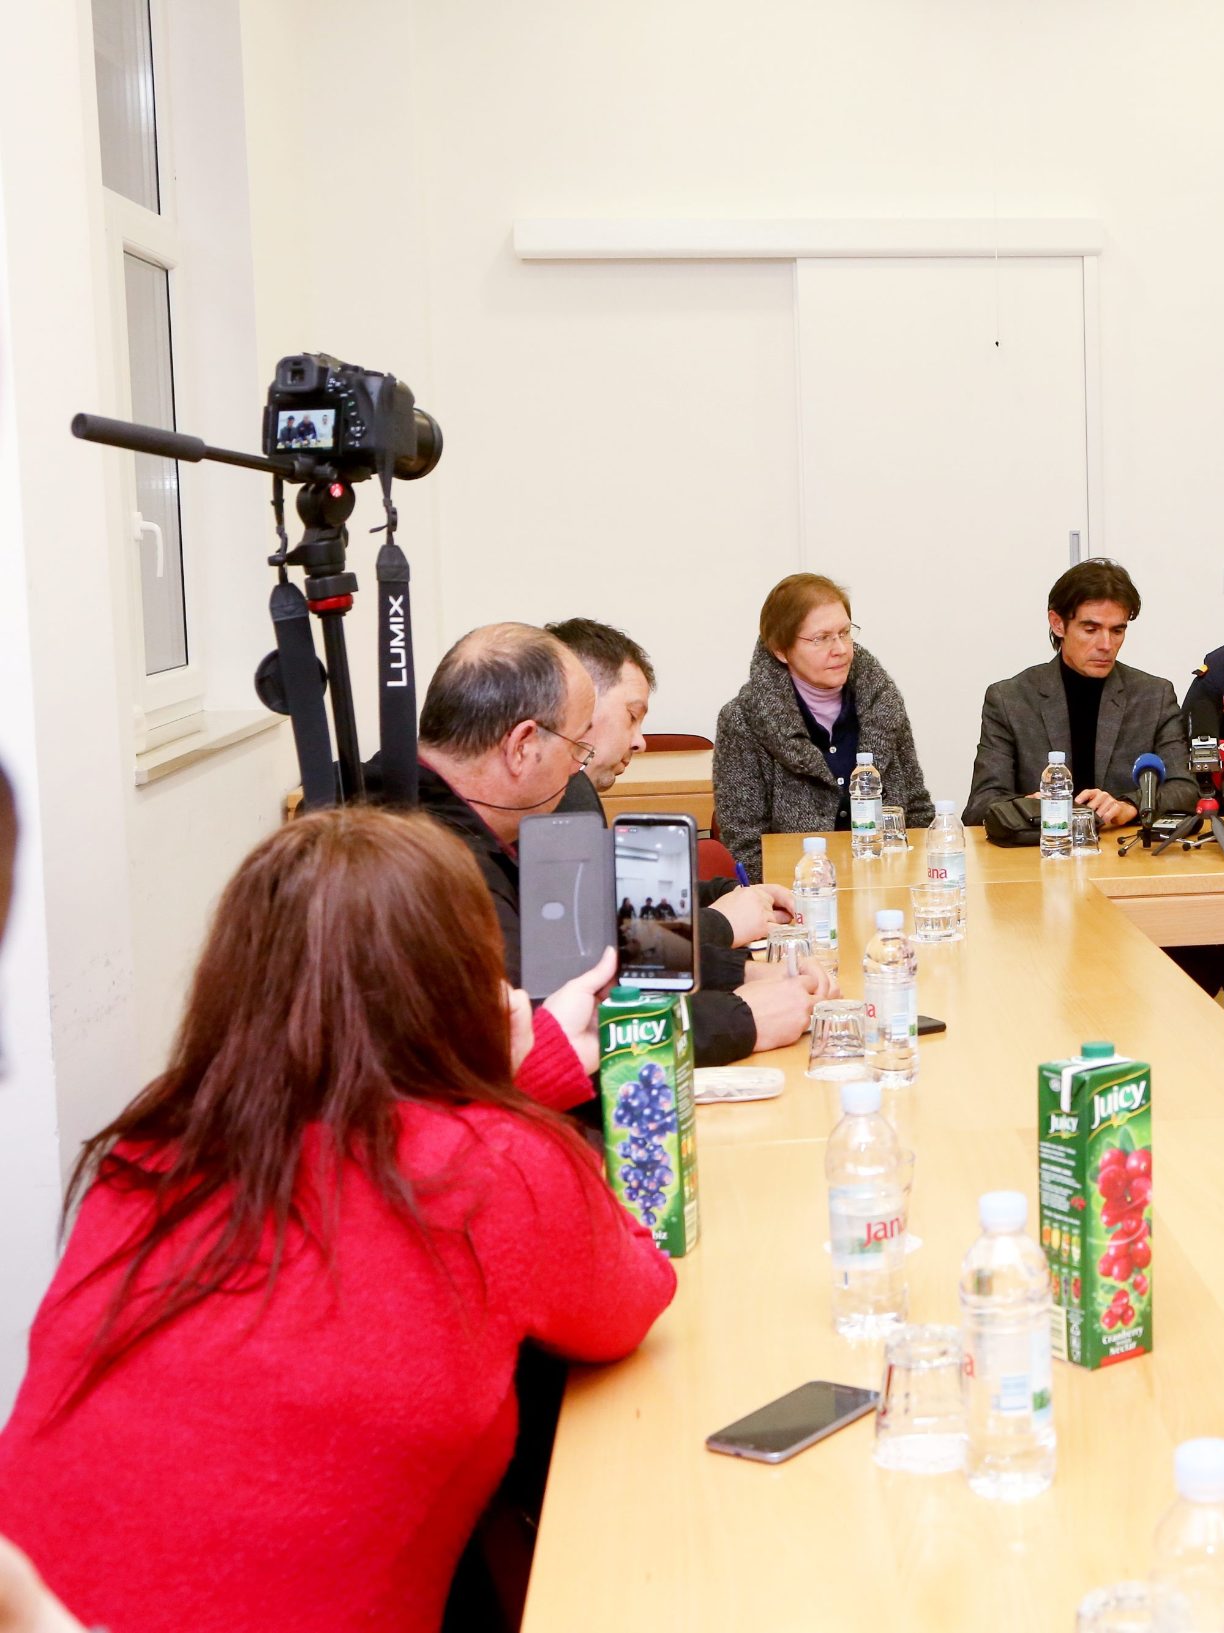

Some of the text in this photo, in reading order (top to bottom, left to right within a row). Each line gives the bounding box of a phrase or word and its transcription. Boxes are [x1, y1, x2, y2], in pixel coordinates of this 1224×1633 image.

[386, 594, 408, 687] LUMIX
[927, 867, 948, 879] ana
[604, 1019, 667, 1052] Juicy
[1090, 1080, 1147, 1130] Juicy
[860, 1216, 905, 1249] Jan
